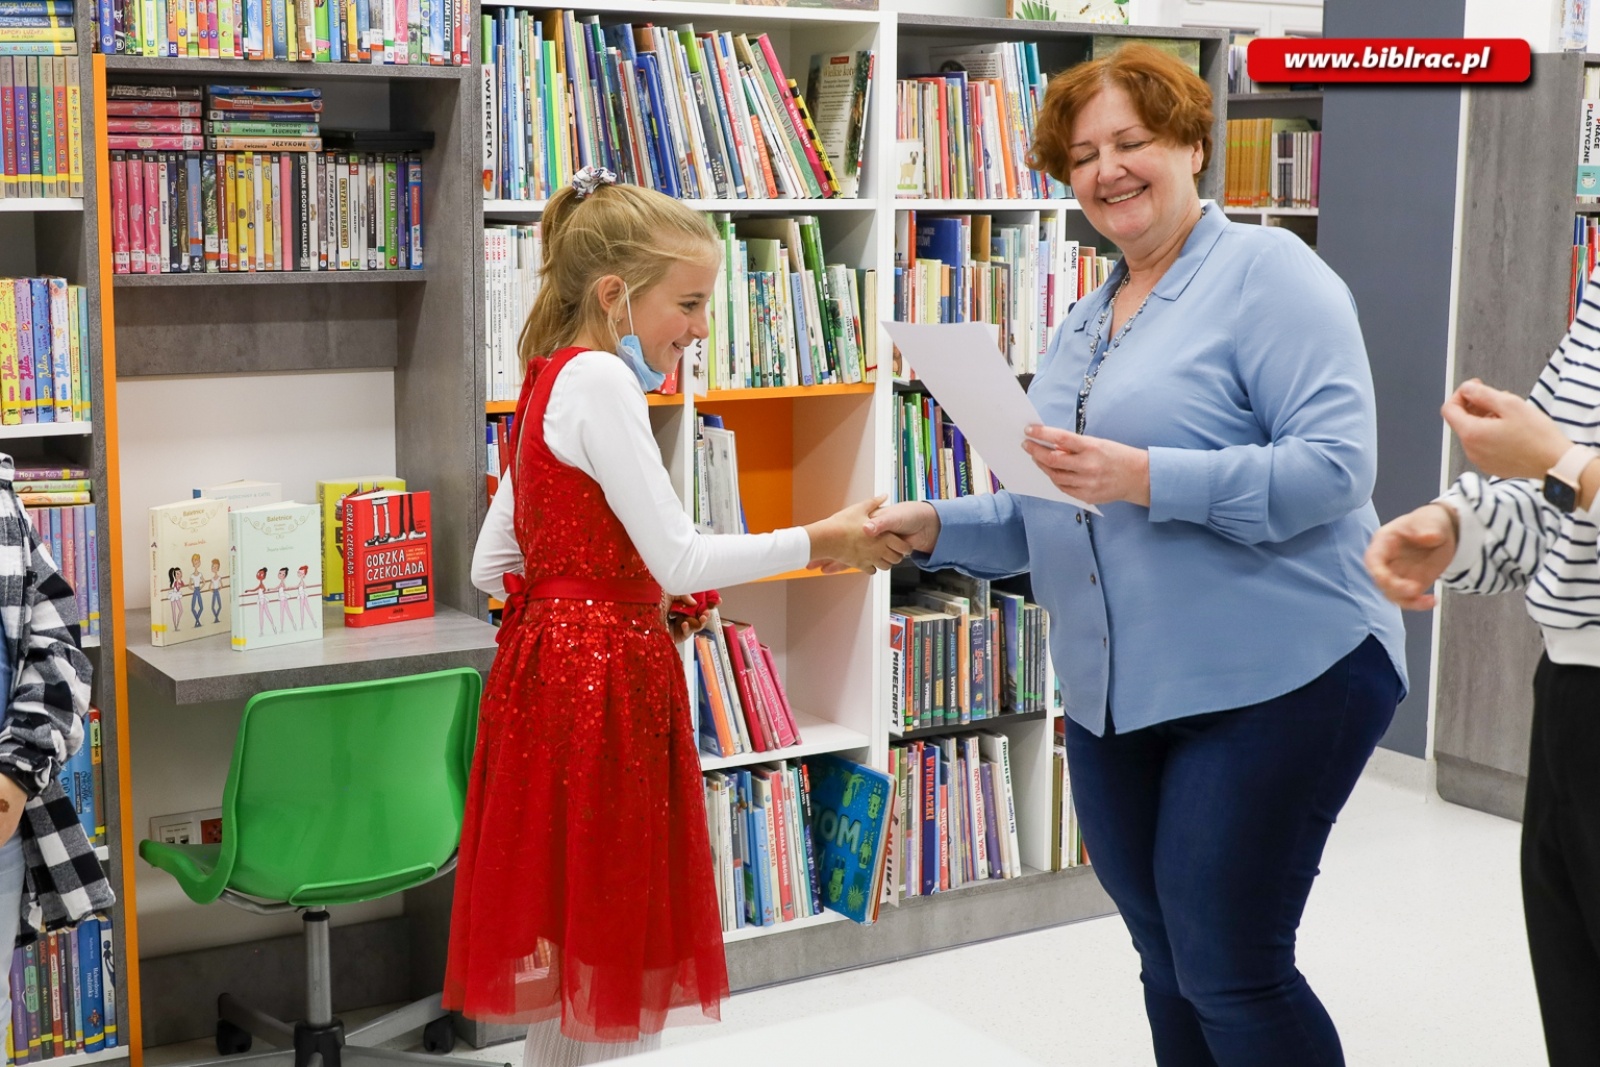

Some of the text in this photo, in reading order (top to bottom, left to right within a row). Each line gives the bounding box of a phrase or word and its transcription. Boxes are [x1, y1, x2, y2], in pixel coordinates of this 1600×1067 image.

[278, 21, 287, 43] DZIECI
[485, 69, 494, 159] ZWIERZĘTA
[271, 140, 307, 149] JĘZYKOWE
[1583, 103, 1594, 164] PLASTYCZNE
[301, 165, 310, 258] URBAN SCOOTER CHALLENG
[389, 188, 397, 212] EUREKA
[1071, 246, 1079, 270] KONIE
[346, 503, 355, 575] GORZKA CZEKOLADA
[366, 549, 405, 568] GORZKA
[366, 561, 425, 581] CZEKOLADA
[891, 651, 900, 727] MINECRAFT
[926, 756, 935, 821] WYNALAZKI
[973, 767, 982, 802] WYNALAZKI
[768, 834, 777, 868] PLANETA
[778, 816, 784, 825] TO
[781, 855, 789, 886] OBECNIE
